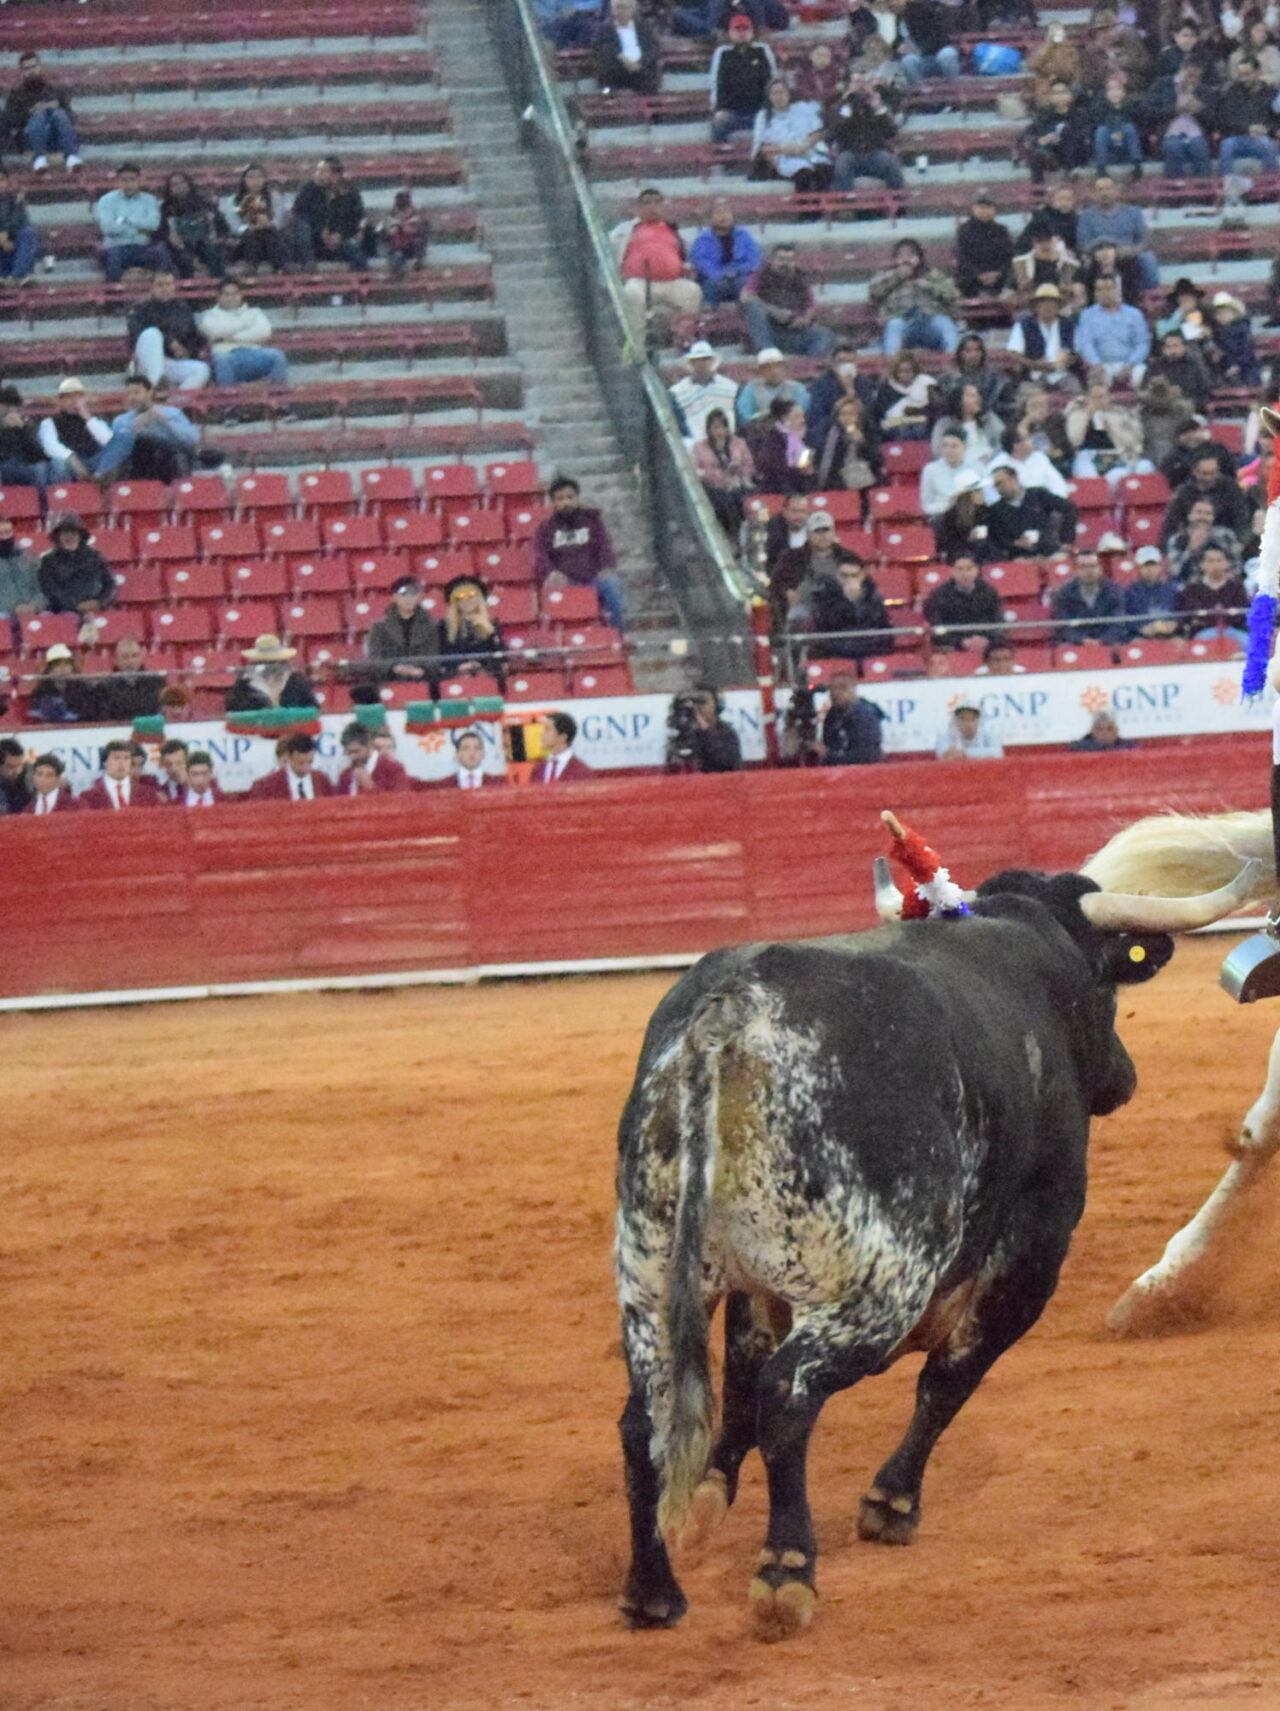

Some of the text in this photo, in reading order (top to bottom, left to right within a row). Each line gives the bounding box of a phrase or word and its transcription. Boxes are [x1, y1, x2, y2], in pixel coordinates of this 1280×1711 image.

[979, 690, 1048, 719] GNP
[1112, 682, 1180, 711] GNP
[582, 713, 651, 742] GNP
